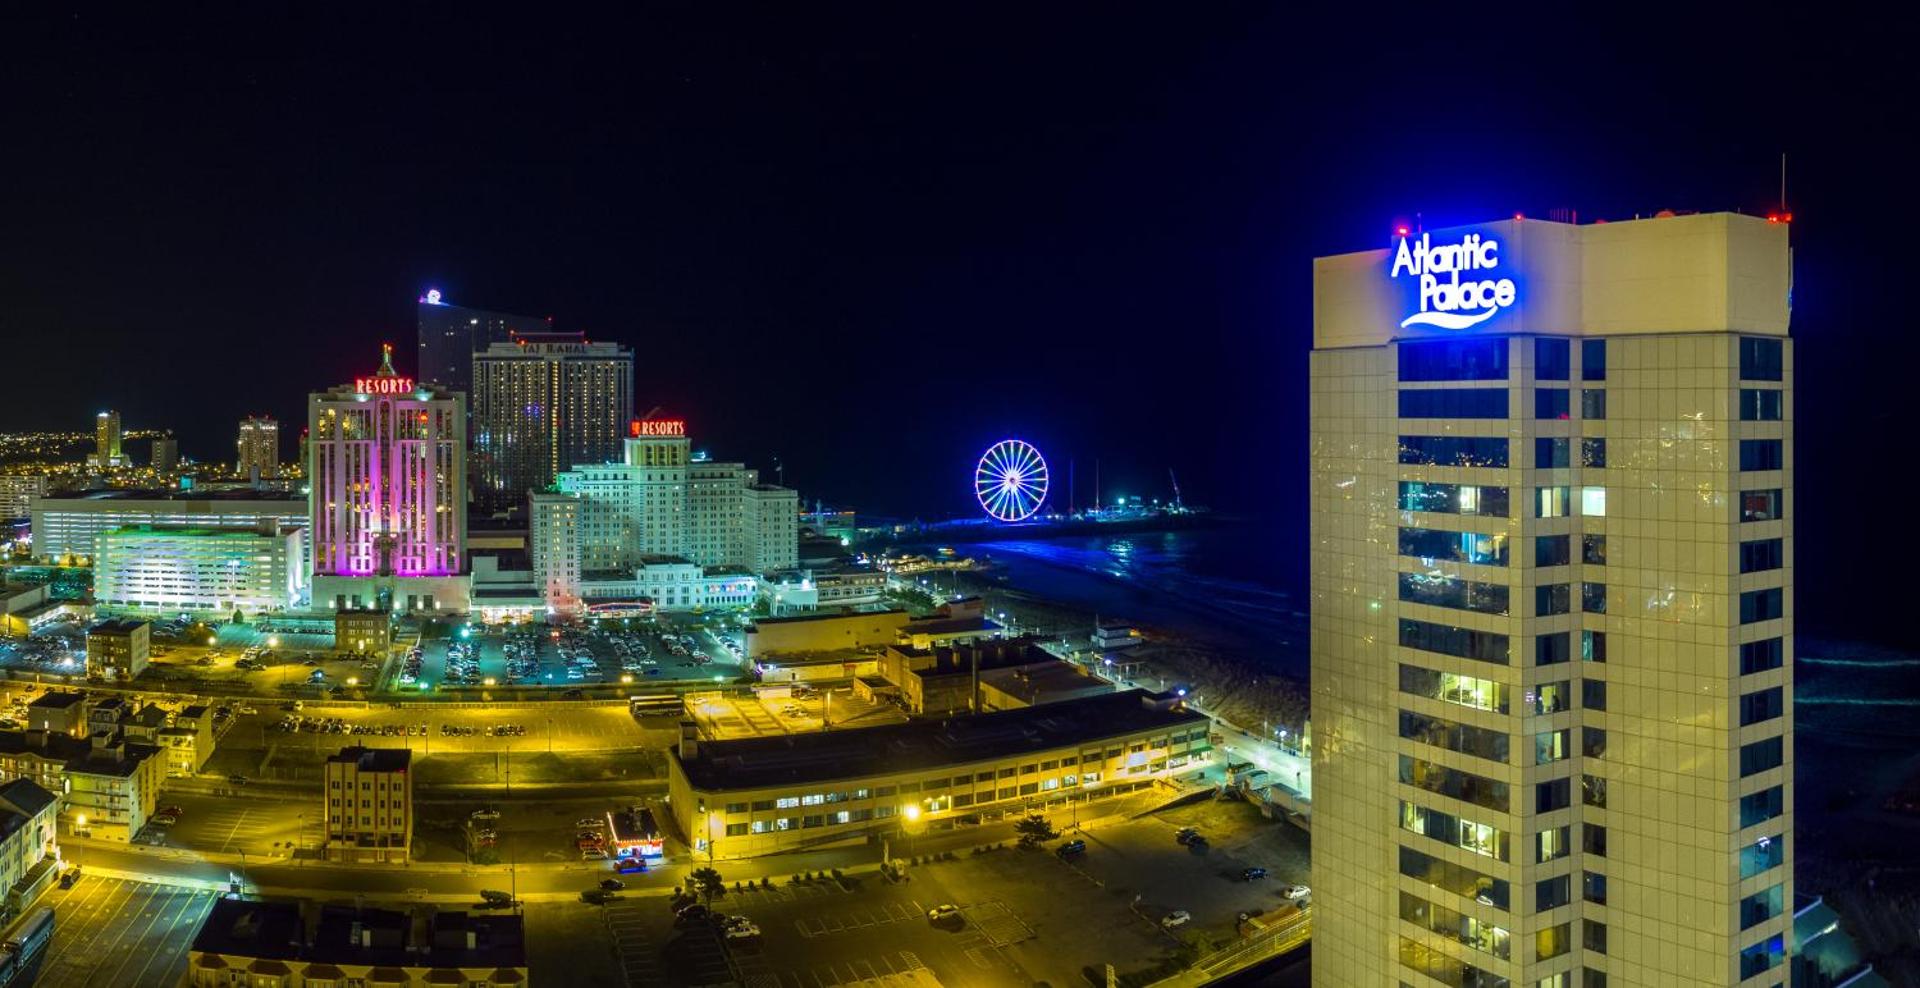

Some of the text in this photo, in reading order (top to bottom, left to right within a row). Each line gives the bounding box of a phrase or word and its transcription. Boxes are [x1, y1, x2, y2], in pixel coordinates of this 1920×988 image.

[1391, 232, 1498, 278] Atlantic
[1420, 269, 1516, 311] Palace
[356, 379, 411, 394] RESORTS
[641, 420, 684, 435] RESORTS
